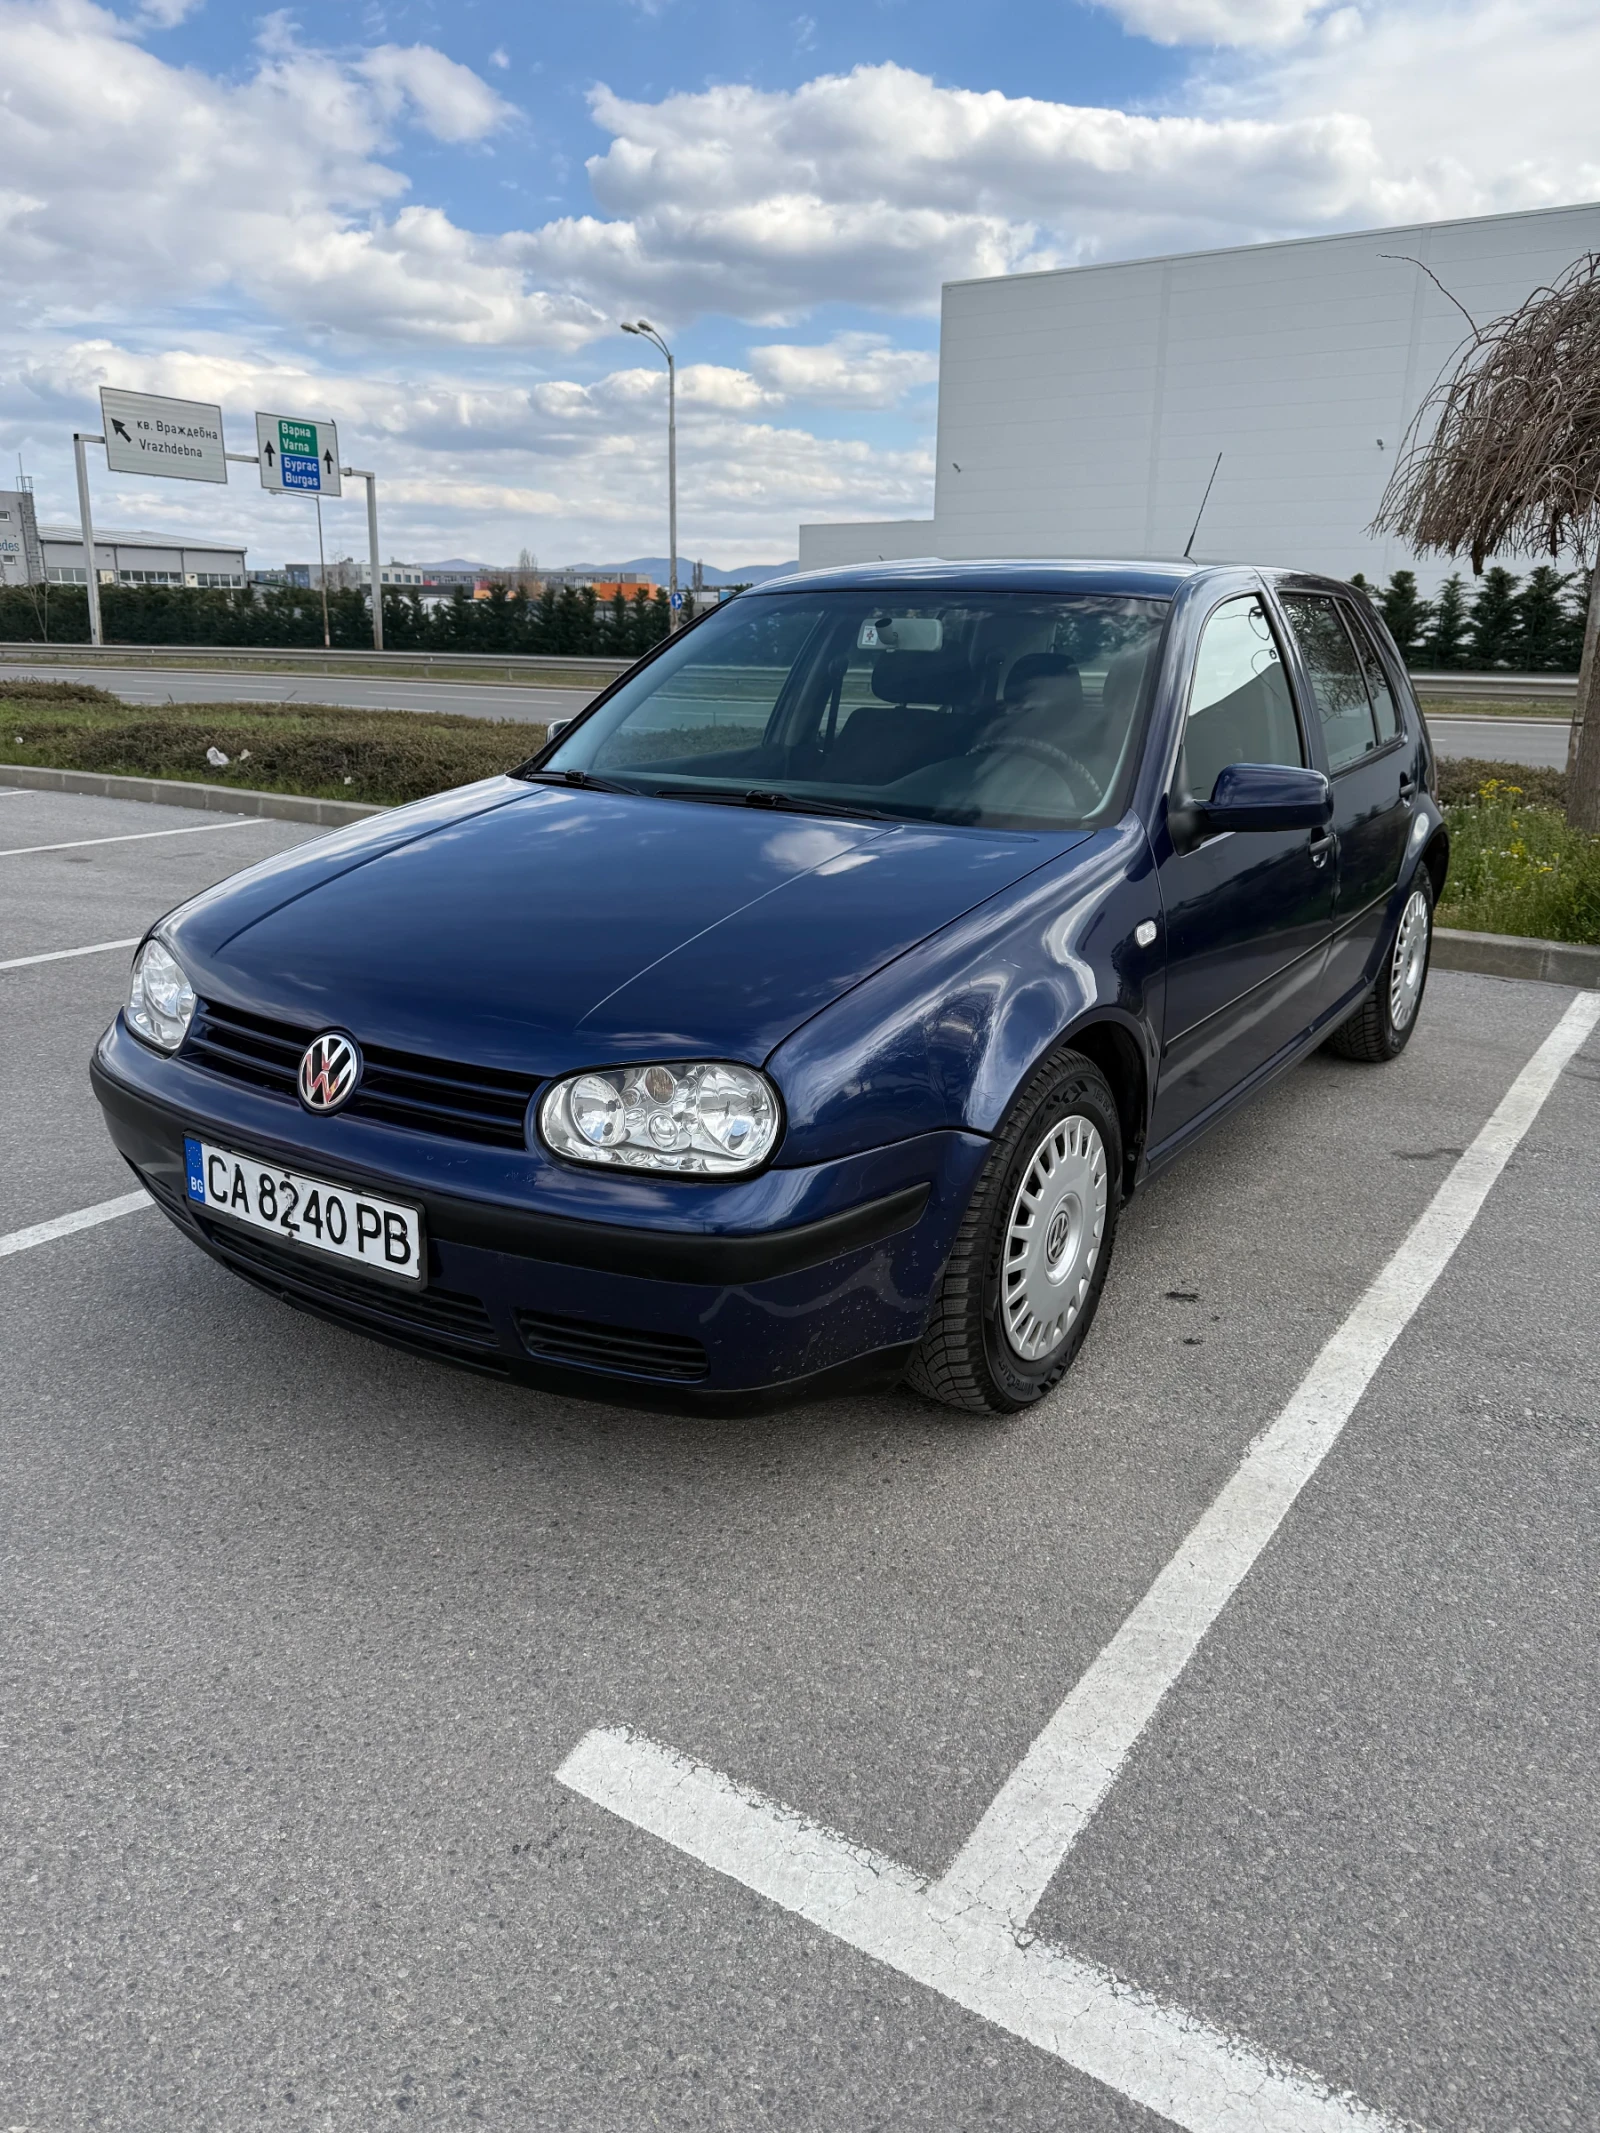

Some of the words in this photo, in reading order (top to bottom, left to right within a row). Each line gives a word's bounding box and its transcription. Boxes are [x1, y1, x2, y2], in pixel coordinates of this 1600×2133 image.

[137, 420, 153, 431] кв.
[156, 421, 218, 440] Враждебна
[281, 423, 311, 438] Варна
[139, 438, 203, 458] Vrazhdebna
[282, 438, 310, 453] Varna
[284, 457, 318, 473] Бургас
[285, 472, 318, 488] Burgas
[190, 1176, 204, 1194] BG
[208, 1154, 250, 1213] CA
[258, 1173, 348, 1245] 8240
[356, 1202, 411, 1265] PB
